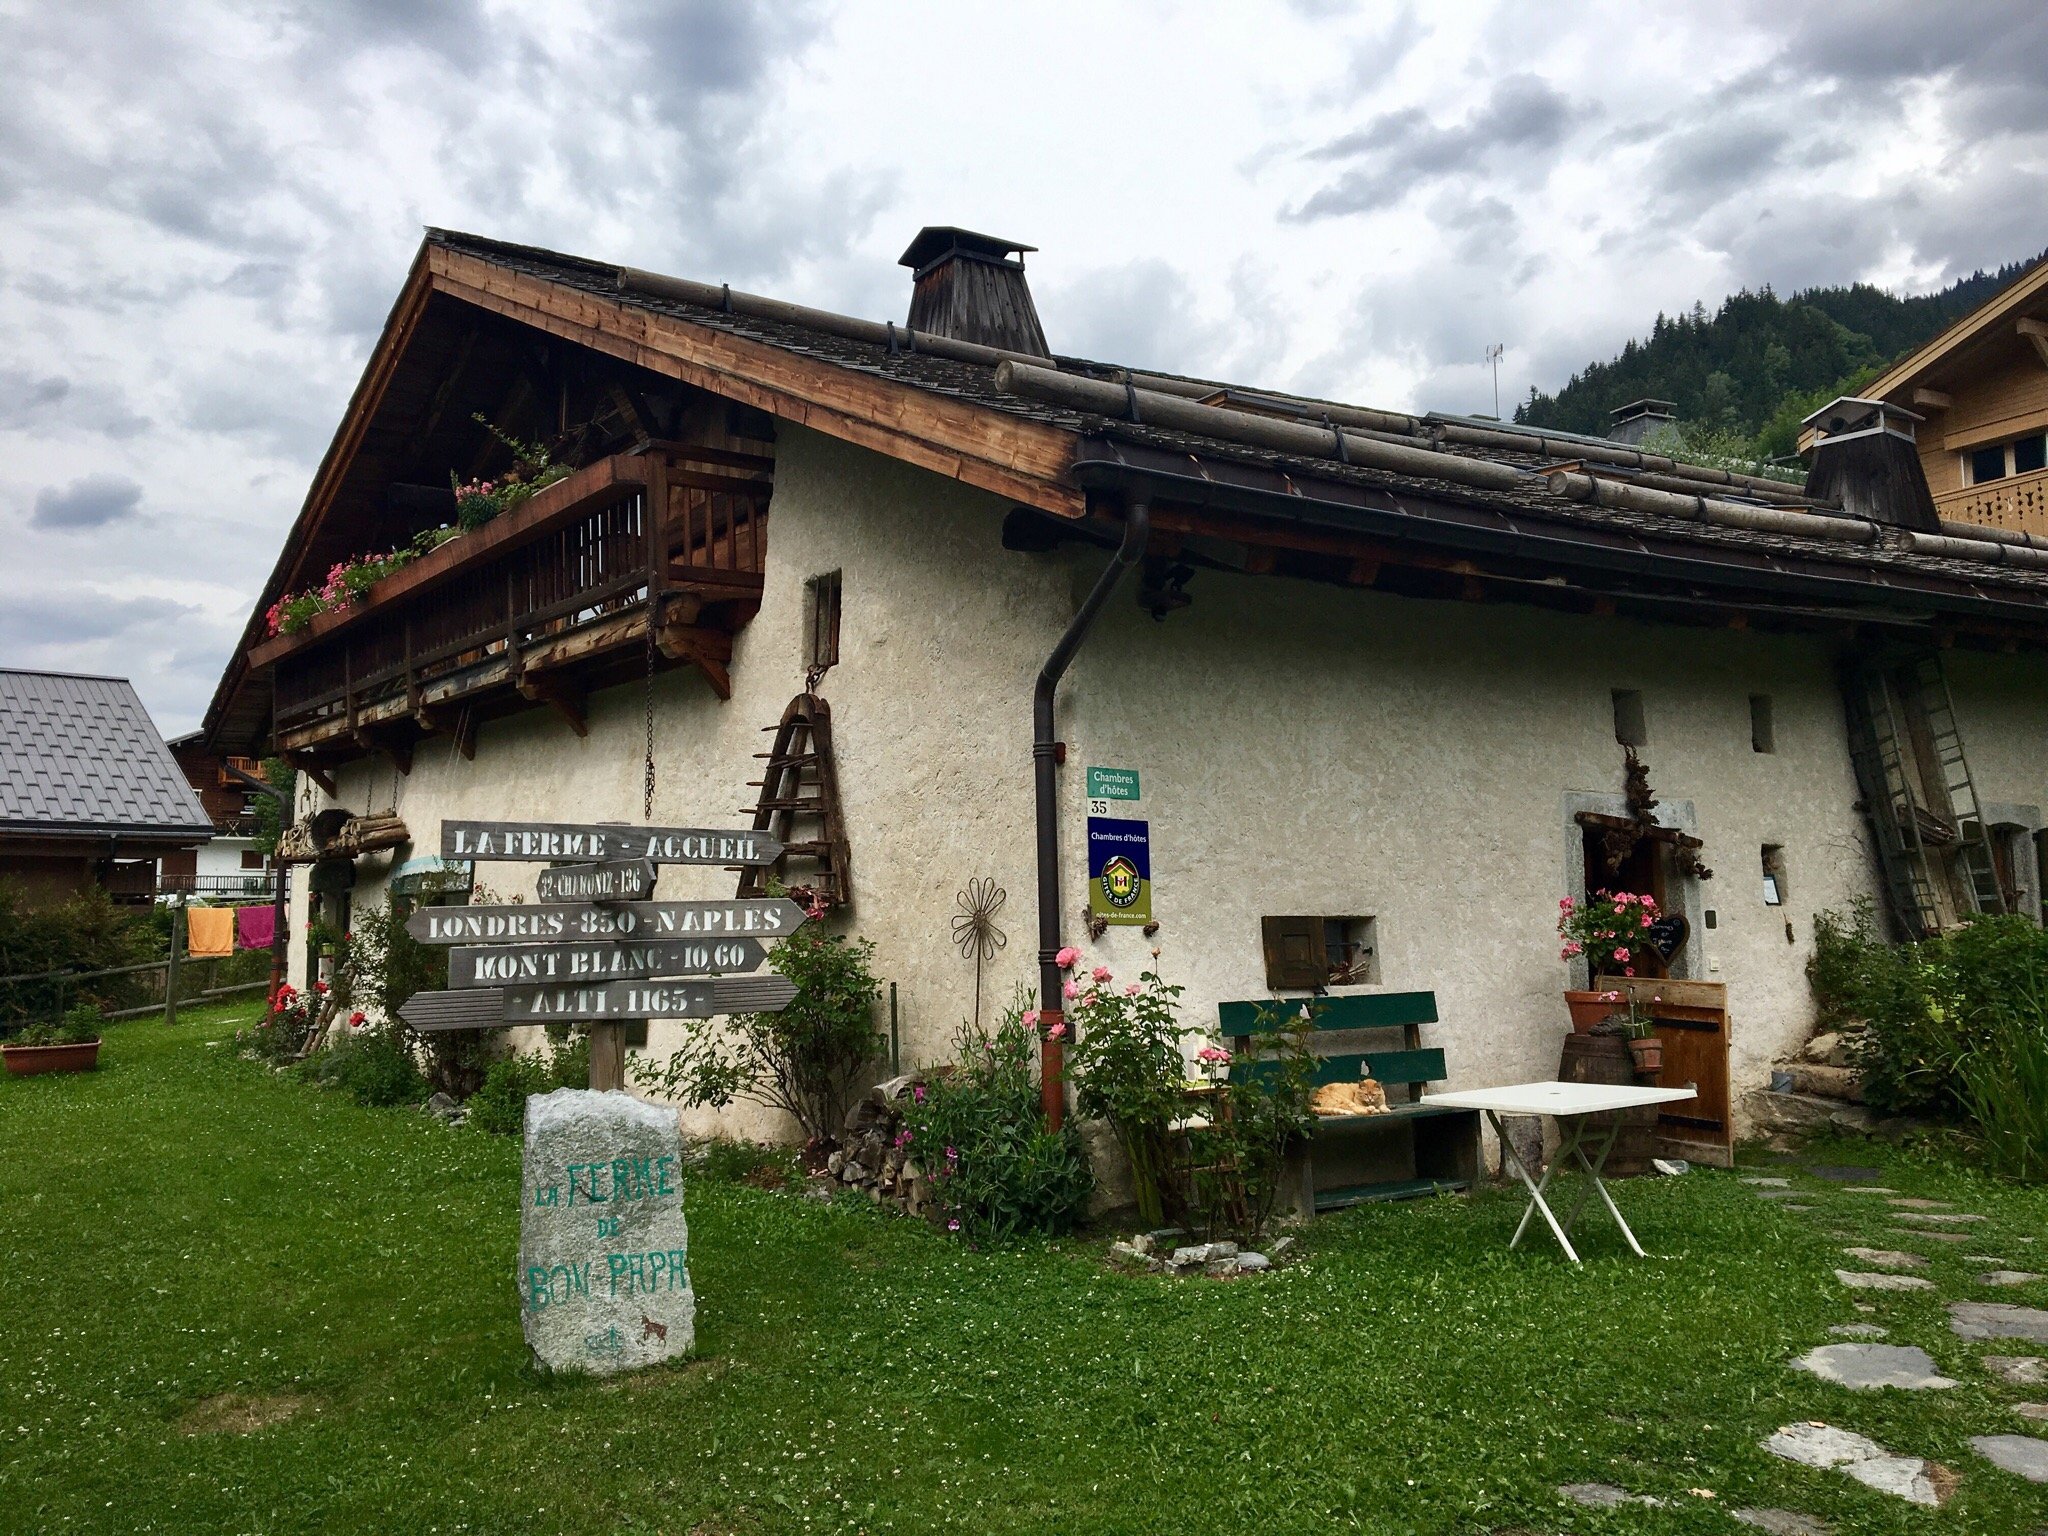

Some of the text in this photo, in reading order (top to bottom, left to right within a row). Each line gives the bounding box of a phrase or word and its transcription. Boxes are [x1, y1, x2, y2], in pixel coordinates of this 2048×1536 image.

[1094, 771, 1133, 784] Chambres
[1100, 784, 1128, 795] d'hôtes
[1092, 801, 1107, 814] 35
[455, 830, 493, 855] LA
[505, 832, 606, 856] FERME
[646, 835, 760, 861] ACCUEIL
[1091, 832, 1146, 843] Chambres d'hôtes
[1125, 878, 1138, 903] FRANCE
[429, 913, 564, 939] LONDRES
[655, 907, 782, 930] NAPLES
[475, 953, 560, 980] MONT
[570, 948, 663, 973] BLANC
[685, 943, 744, 971] 10,60
[628, 988, 687, 1012] 1165
[535, 1155, 674, 1207] LA FERME
[597, 1217, 620, 1238] DE
[528, 1249, 687, 1312] BON PAPA
